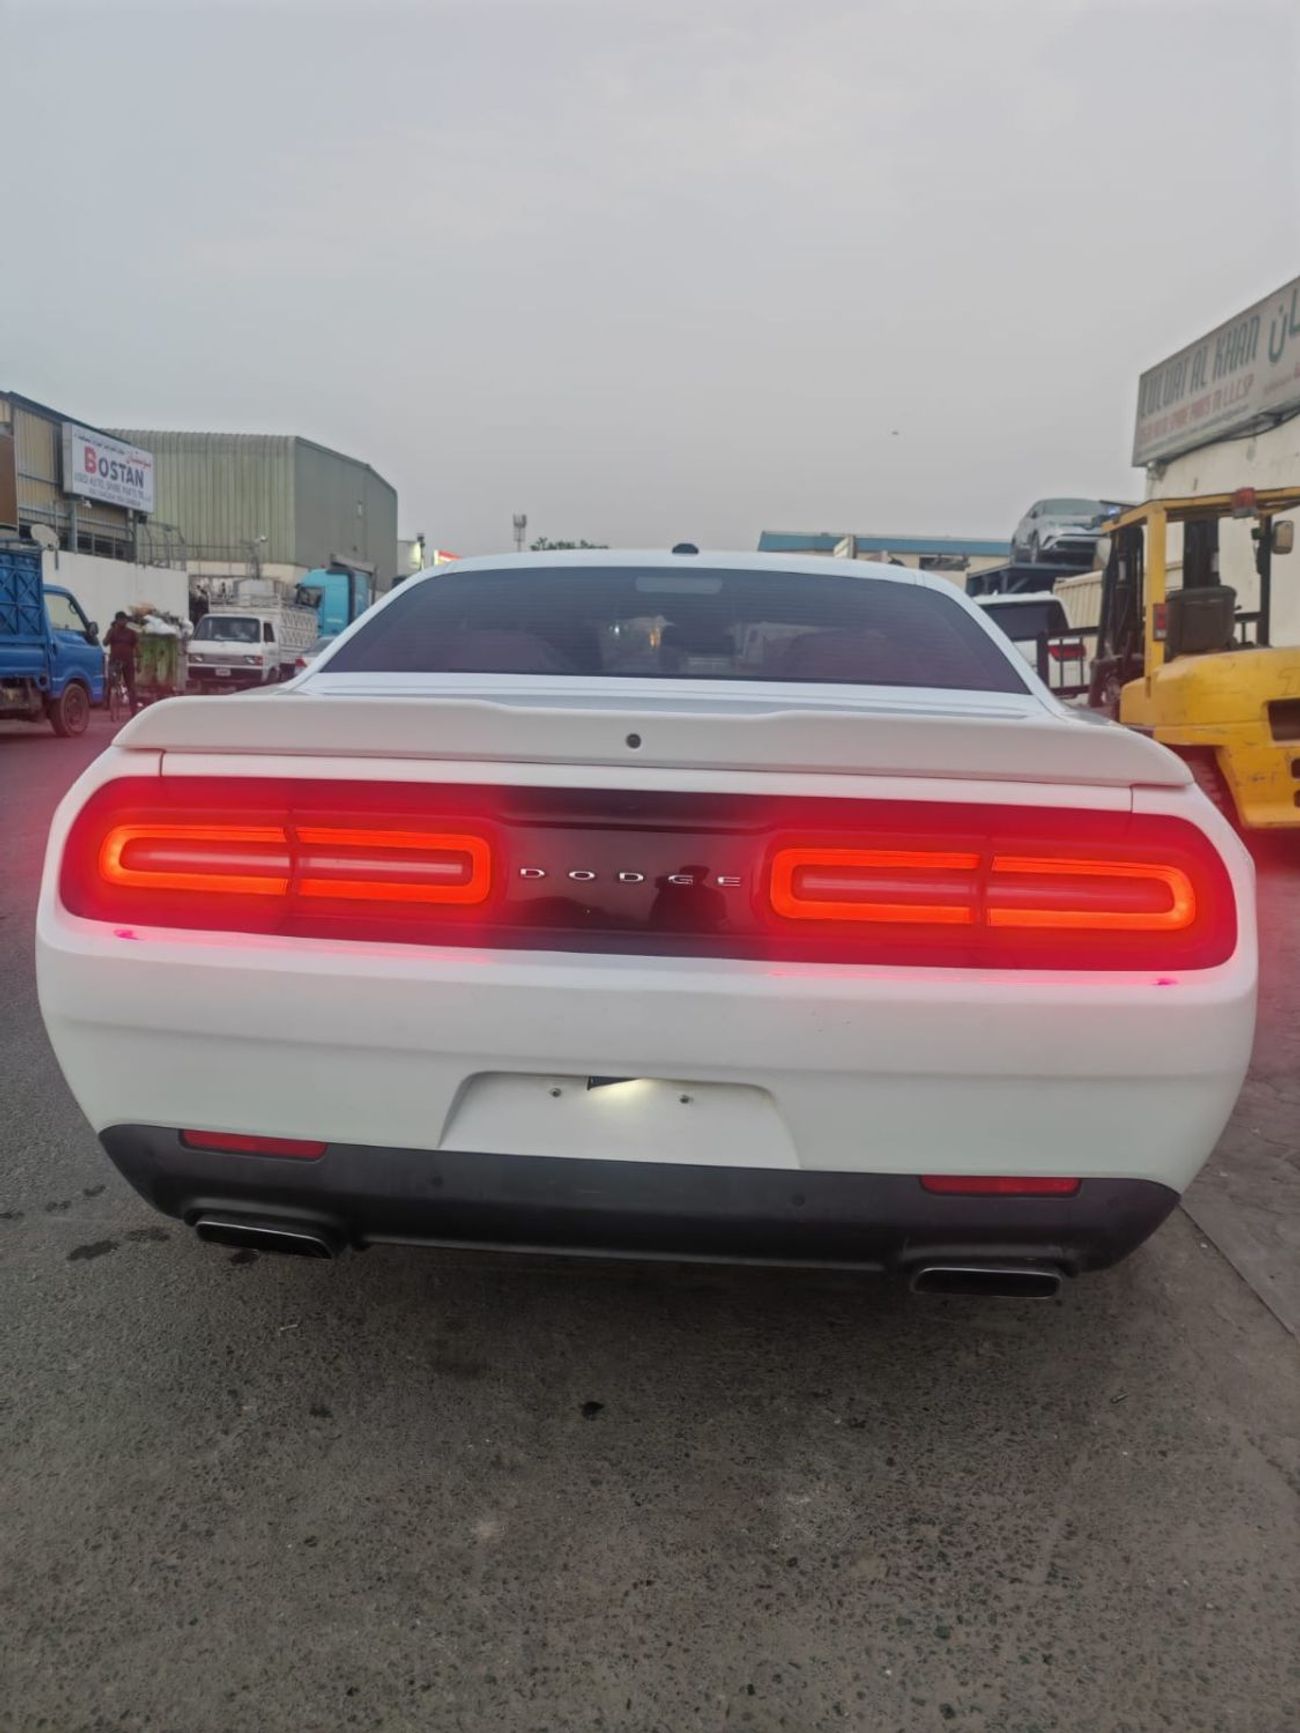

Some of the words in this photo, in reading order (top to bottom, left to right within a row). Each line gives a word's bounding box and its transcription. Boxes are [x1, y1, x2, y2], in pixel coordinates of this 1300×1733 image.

[1190, 347, 1207, 393] AL
[1212, 316, 1260, 383] KHAN
[84, 446, 144, 488] BOSTAN
[520, 868, 741, 887] DODGE
